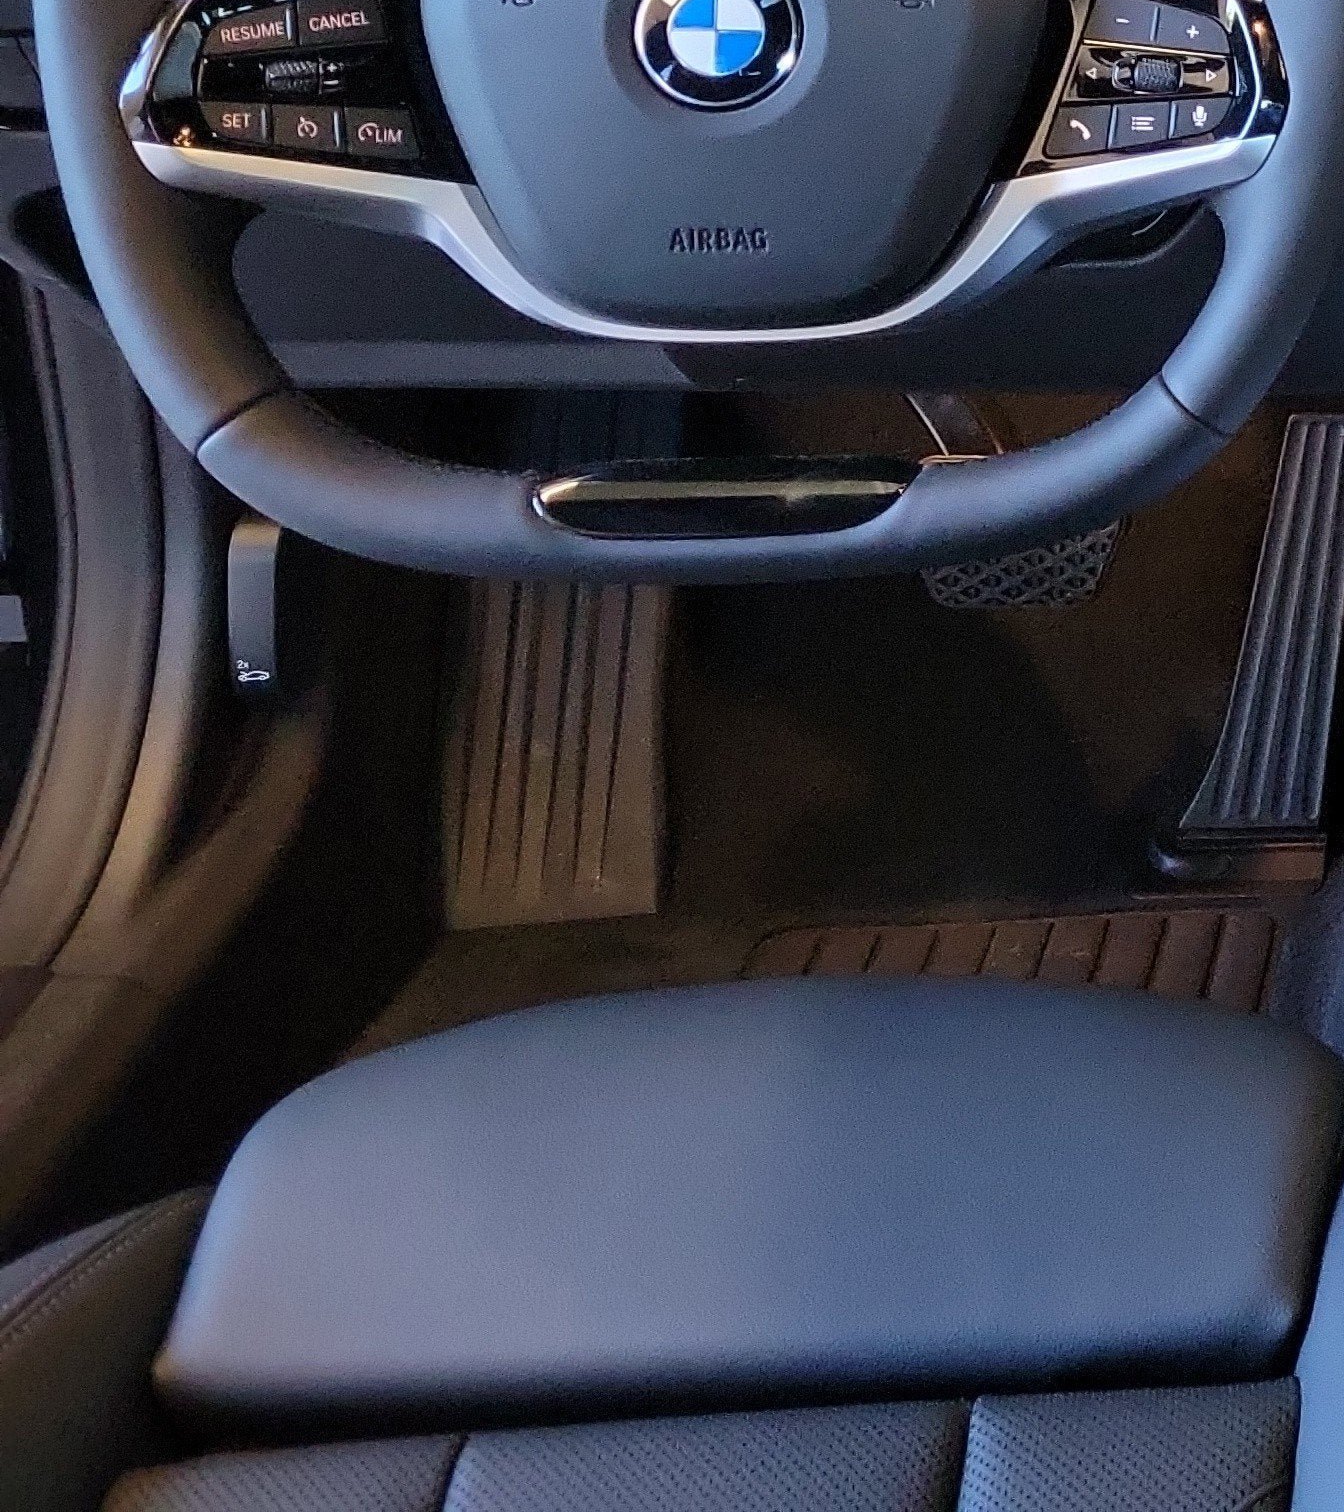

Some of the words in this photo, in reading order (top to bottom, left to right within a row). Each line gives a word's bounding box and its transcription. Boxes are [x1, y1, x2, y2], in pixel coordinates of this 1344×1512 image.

[220, 20, 285, 43] RESUME
[308, 10, 370, 32] CANCEL
[222, 112, 252, 129] SET
[375, 127, 404, 144] LIM
[669, 226, 770, 255] AIRBAG
